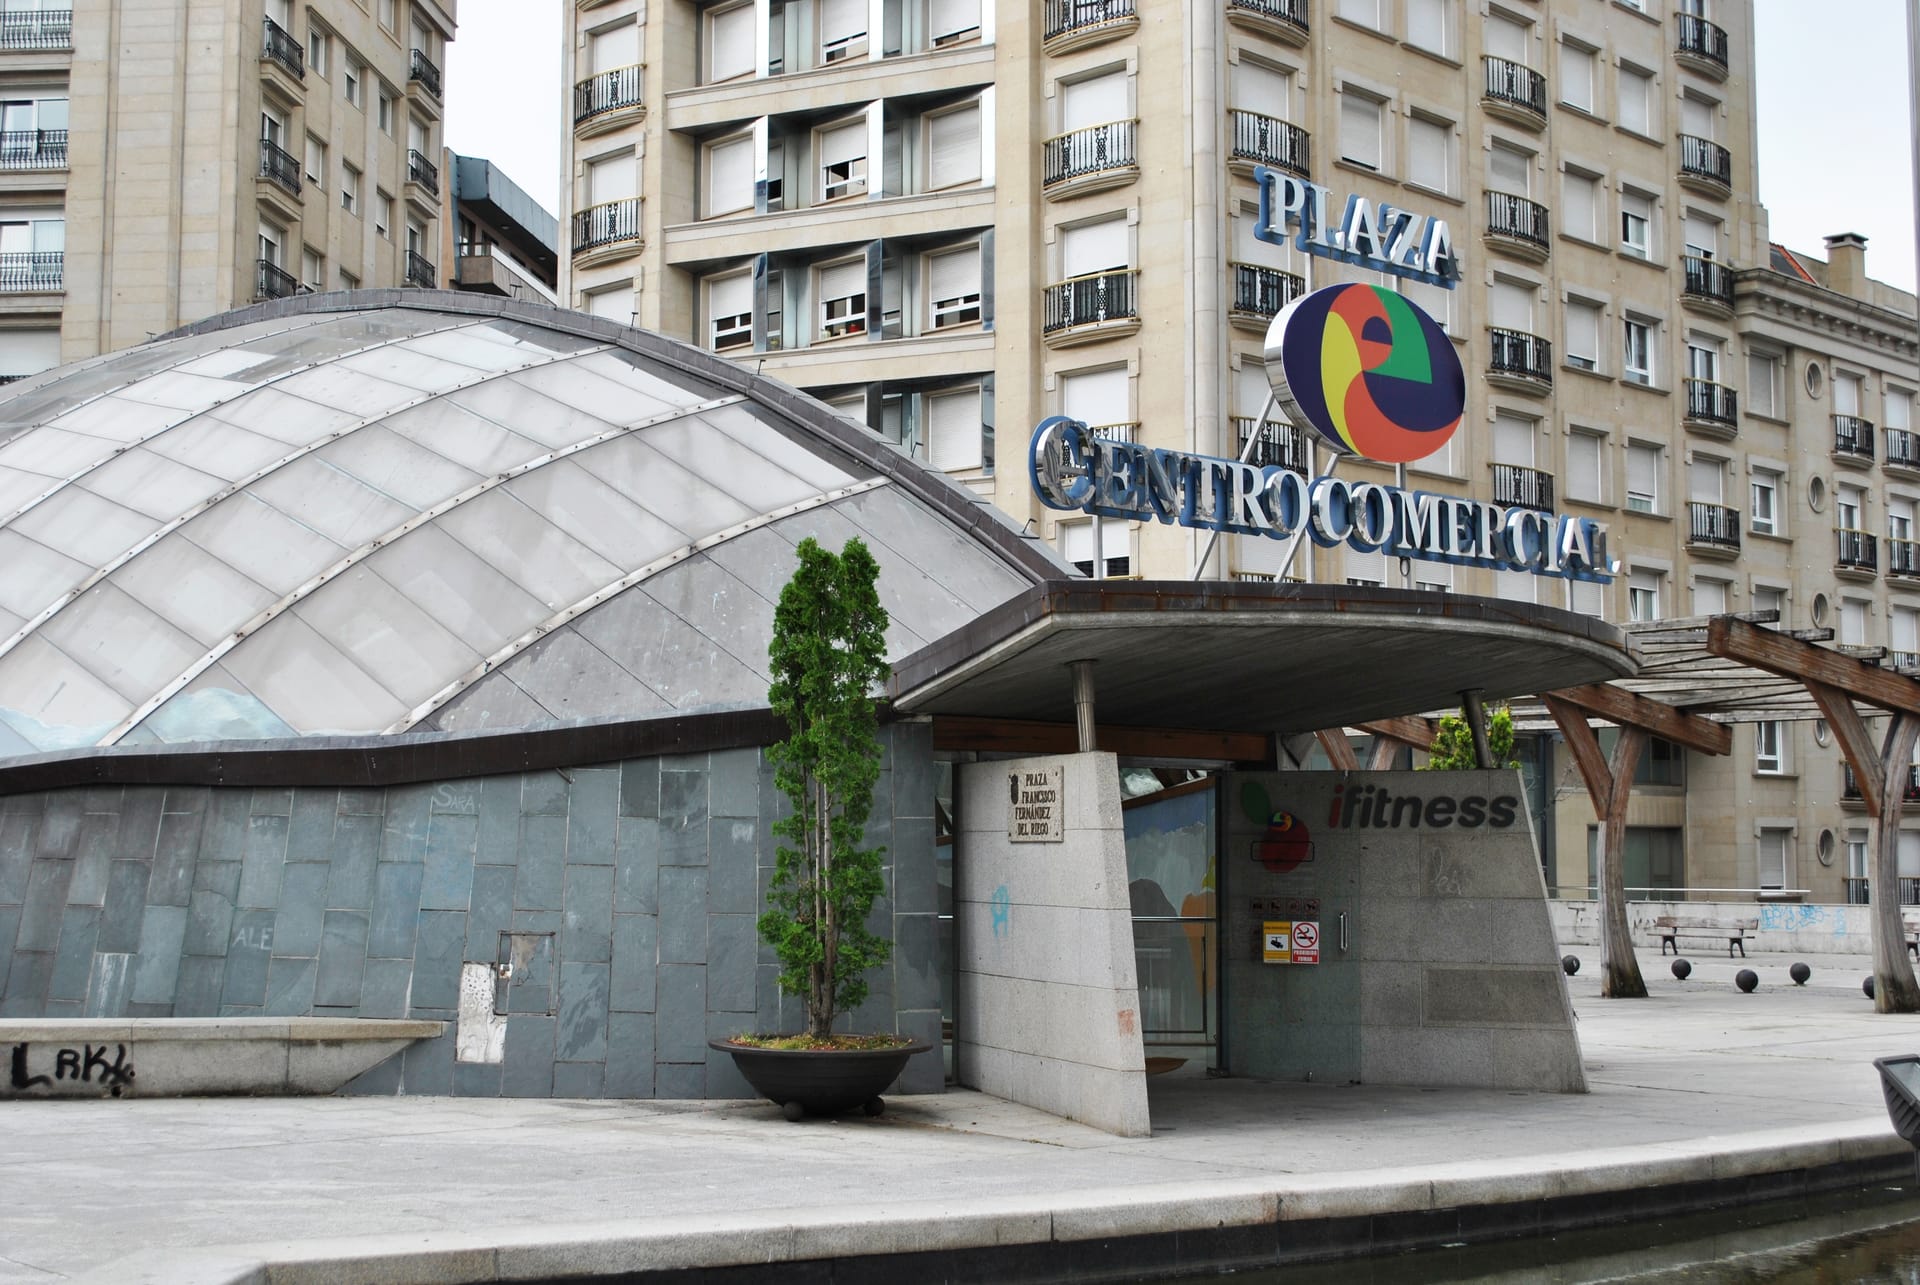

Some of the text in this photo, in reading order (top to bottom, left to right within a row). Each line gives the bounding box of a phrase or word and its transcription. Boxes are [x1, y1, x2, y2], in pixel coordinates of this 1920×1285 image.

[1254, 166, 1462, 290] PLAZA
[1026, 774, 1048, 786] PRAZA
[1022, 791, 1056, 804] FRANCISCO
[1015, 804, 1050, 819] FERNÁNDEZ
[1328, 784, 1518, 829] ifitness
[1018, 822, 1048, 835] DEL RIEGO
